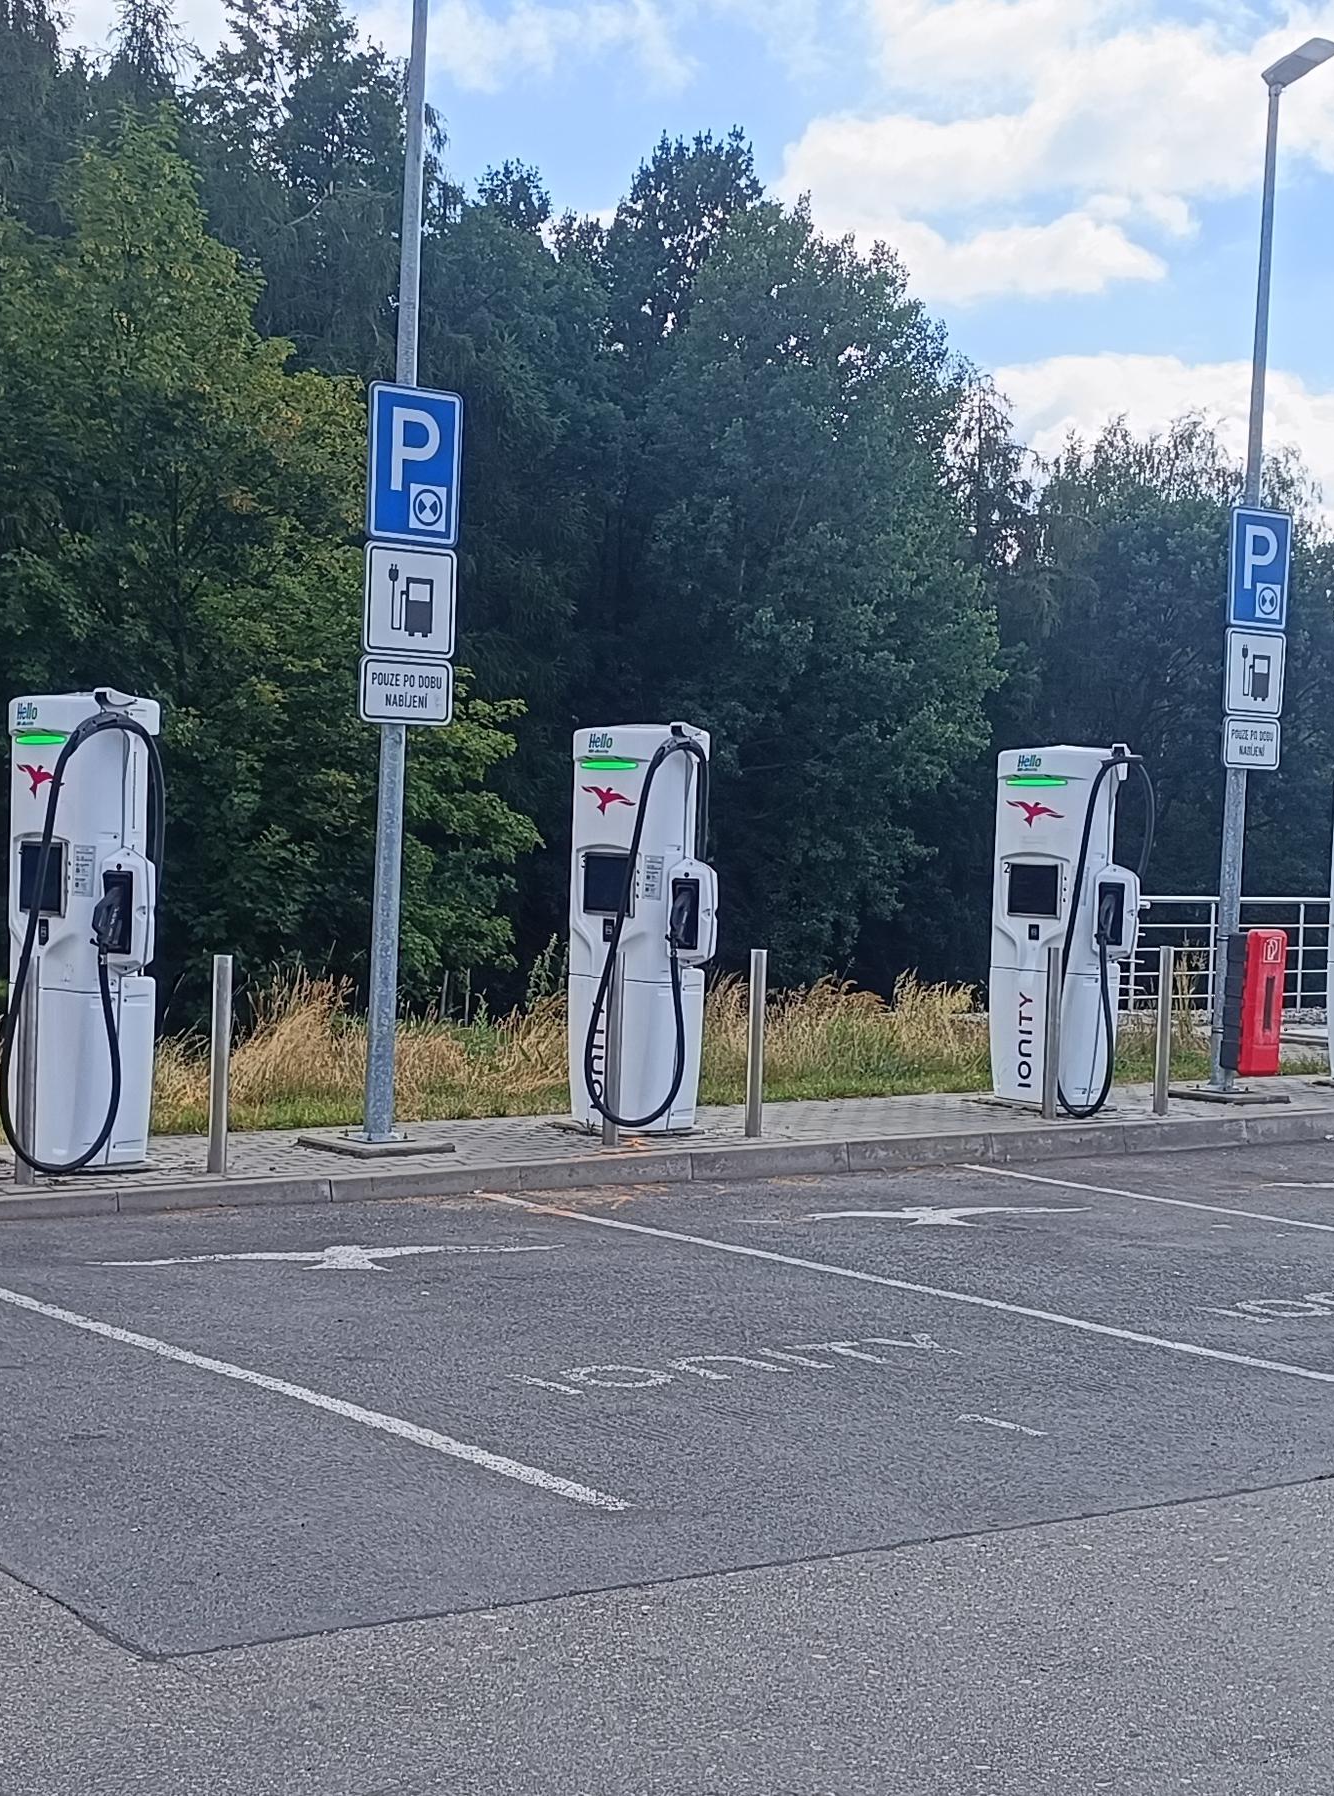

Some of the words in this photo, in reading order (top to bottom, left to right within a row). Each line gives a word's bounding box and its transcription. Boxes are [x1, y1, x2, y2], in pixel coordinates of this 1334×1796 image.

[390, 406, 440, 491] P
[1243, 524, 1278, 589] P
[371, 672, 401, 687] POUZE
[403, 674, 415, 688] PO
[419, 675, 442, 690] DOBU
[385, 692, 428, 709] NABÍJENÍ
[17, 702, 38, 720] Hello
[588, 733, 613, 748] Hello
[1017, 754, 1042, 767] Hello
